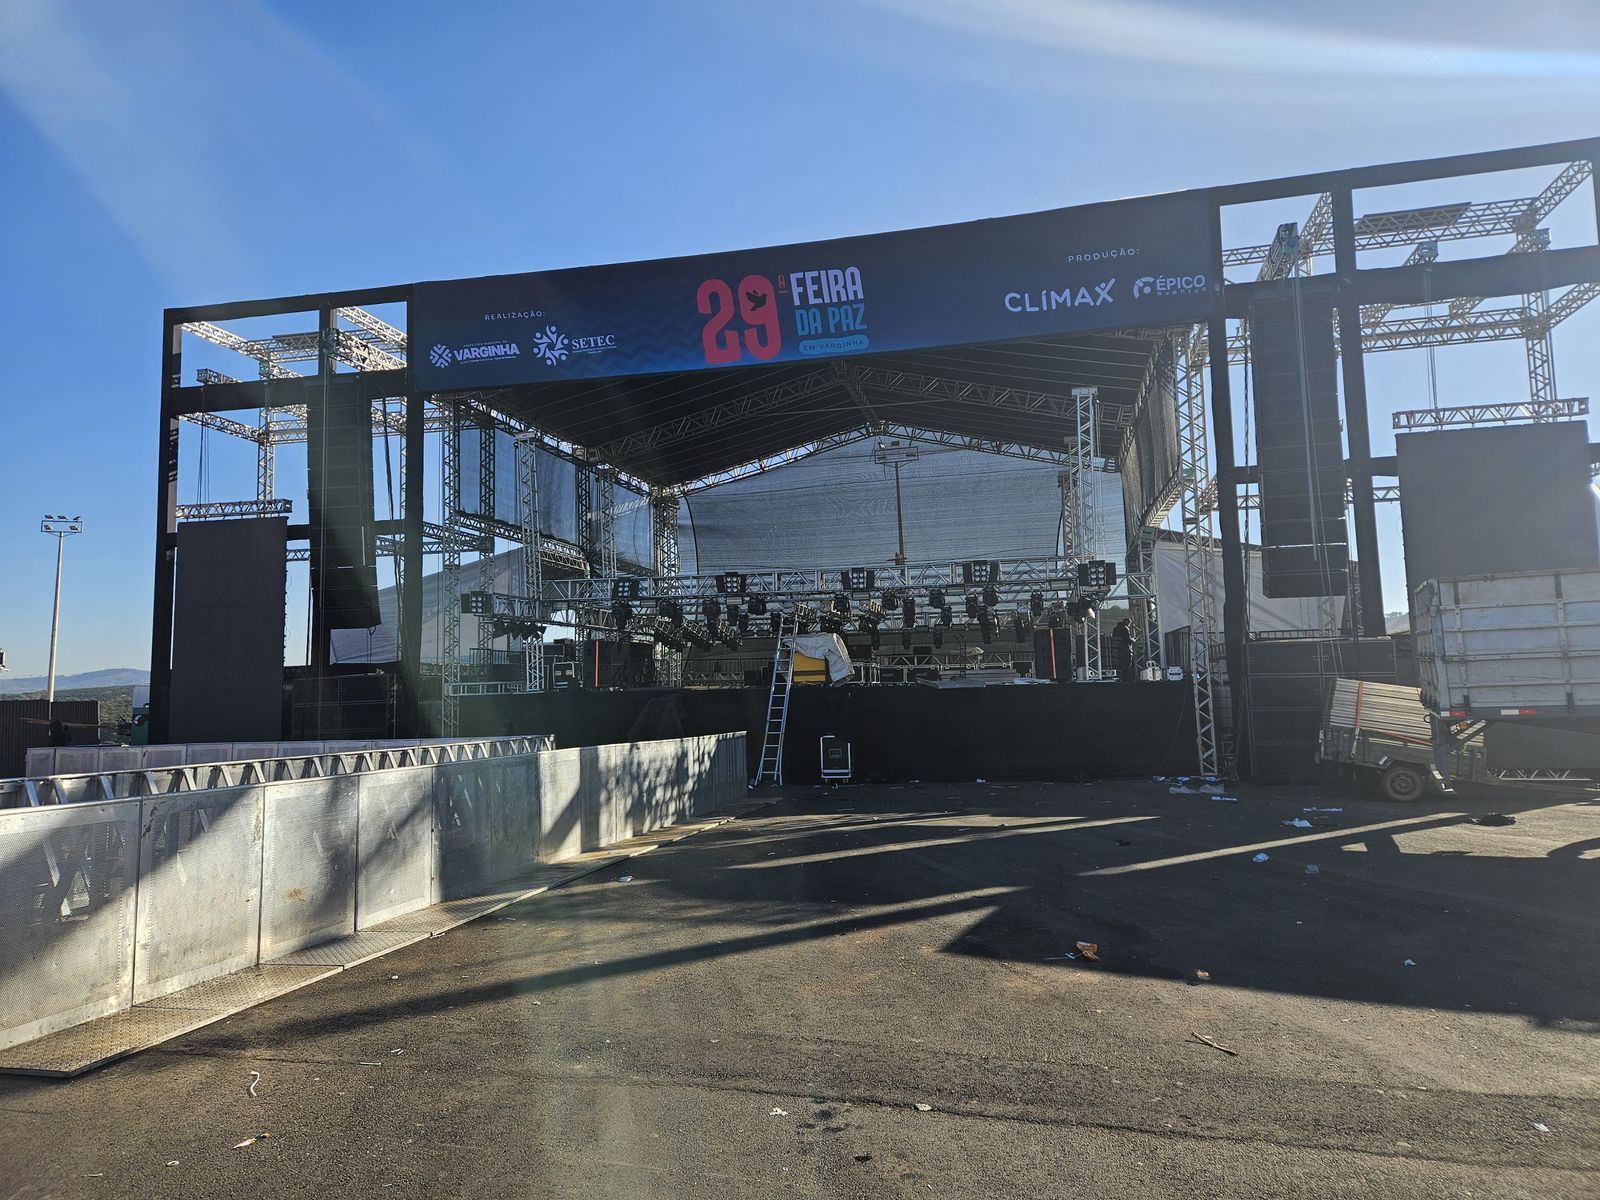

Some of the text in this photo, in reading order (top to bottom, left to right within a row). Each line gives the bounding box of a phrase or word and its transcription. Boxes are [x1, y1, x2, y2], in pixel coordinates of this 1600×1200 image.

[1068, 248, 1140, 263] PRODUÇÃO:
[789, 266, 864, 306] FEIRA
[1156, 275, 1206, 291] ÉPICO
[485, 311, 546, 321] REALIZAÇÃO:
[794, 303, 868, 336] DA PAZ
[571, 334, 616, 350] SETEC
[453, 343, 520, 361] VARGINHA
